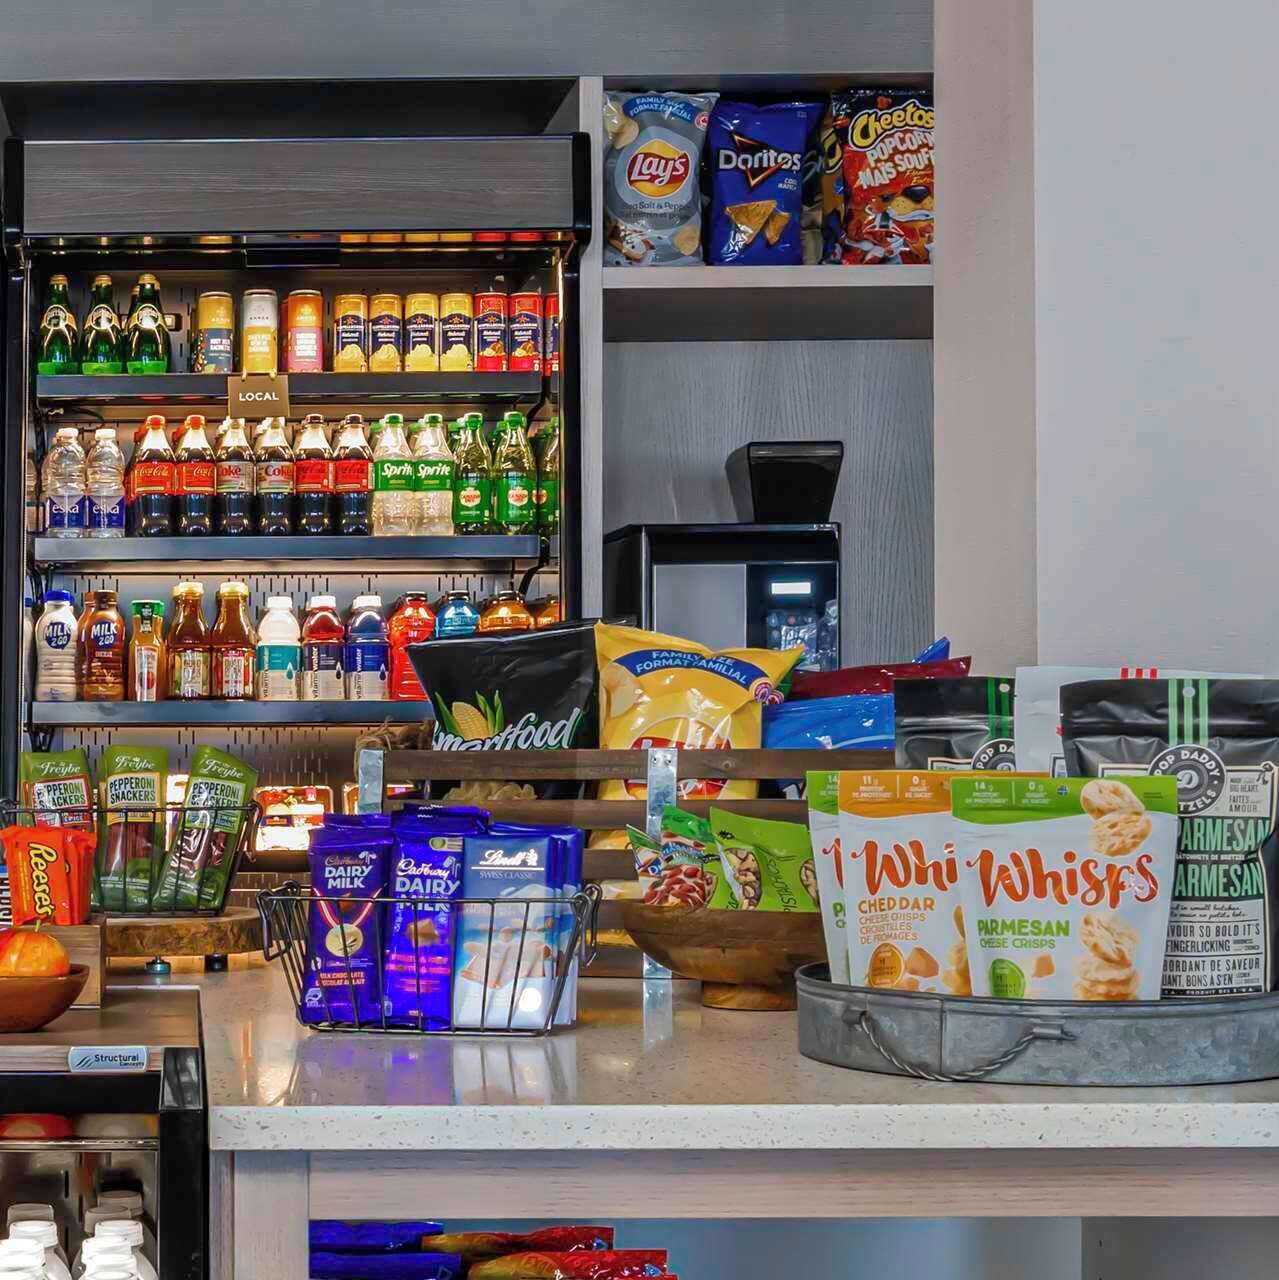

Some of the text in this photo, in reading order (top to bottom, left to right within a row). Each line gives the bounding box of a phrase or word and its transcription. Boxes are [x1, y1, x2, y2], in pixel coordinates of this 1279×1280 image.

[852, 102, 934, 147] Cheetos
[719, 149, 801, 175] Doritos
[630, 153, 687, 187] Lay's
[238, 391, 280, 402] LOCAL
[417, 463, 451, 478] Sprite
[52, 503, 79, 514] eska
[46, 622, 71, 638] MILK
[91, 620, 117, 640] MILK
[652, 651, 701, 661] FAMILY
[636, 658, 690, 673] FORMAT
[40, 761, 81, 776] Freybe
[115, 755, 156, 771] Freybe
[204, 758, 244, 779] Freybe
[1154, 750, 1221, 777] POP DADDY
[36, 781, 84, 799] PPPERONI
[109, 778, 155, 792] PEPPERONI
[192, 781, 240, 799] PEPPERONI
[974, 781, 985, 790] 14
[39, 794, 85, 809] SACKERS
[110, 790, 155, 805] SNACKERS
[1178, 789, 1218, 812] TZELS
[324, 865, 372, 879] DAIRY
[397, 858, 451, 880] Cadbury
[851, 838, 959, 896] Whi
[327, 877, 365, 889] MILK
[479, 871, 502, 880] SWISS
[966, 848, 1158, 910] Whisps
[1175, 862, 1264, 898] ARMESAN
[395, 879, 461, 896] DAIRY
[857, 897, 936, 914] CHEDDAR
[859, 914, 890, 923] CHEESE
[977, 919, 1070, 937] PARMESAN
[1199, 924, 1239, 938] SO BOLD
[860, 931, 918, 945] DE FROMAGES
[1012, 937, 1056, 949] CRISPS
[1210, 958, 1260, 972] DE SAVEUR
[1186, 974, 1207, 987] BONS
[95, 1054, 139, 1062] Structural
